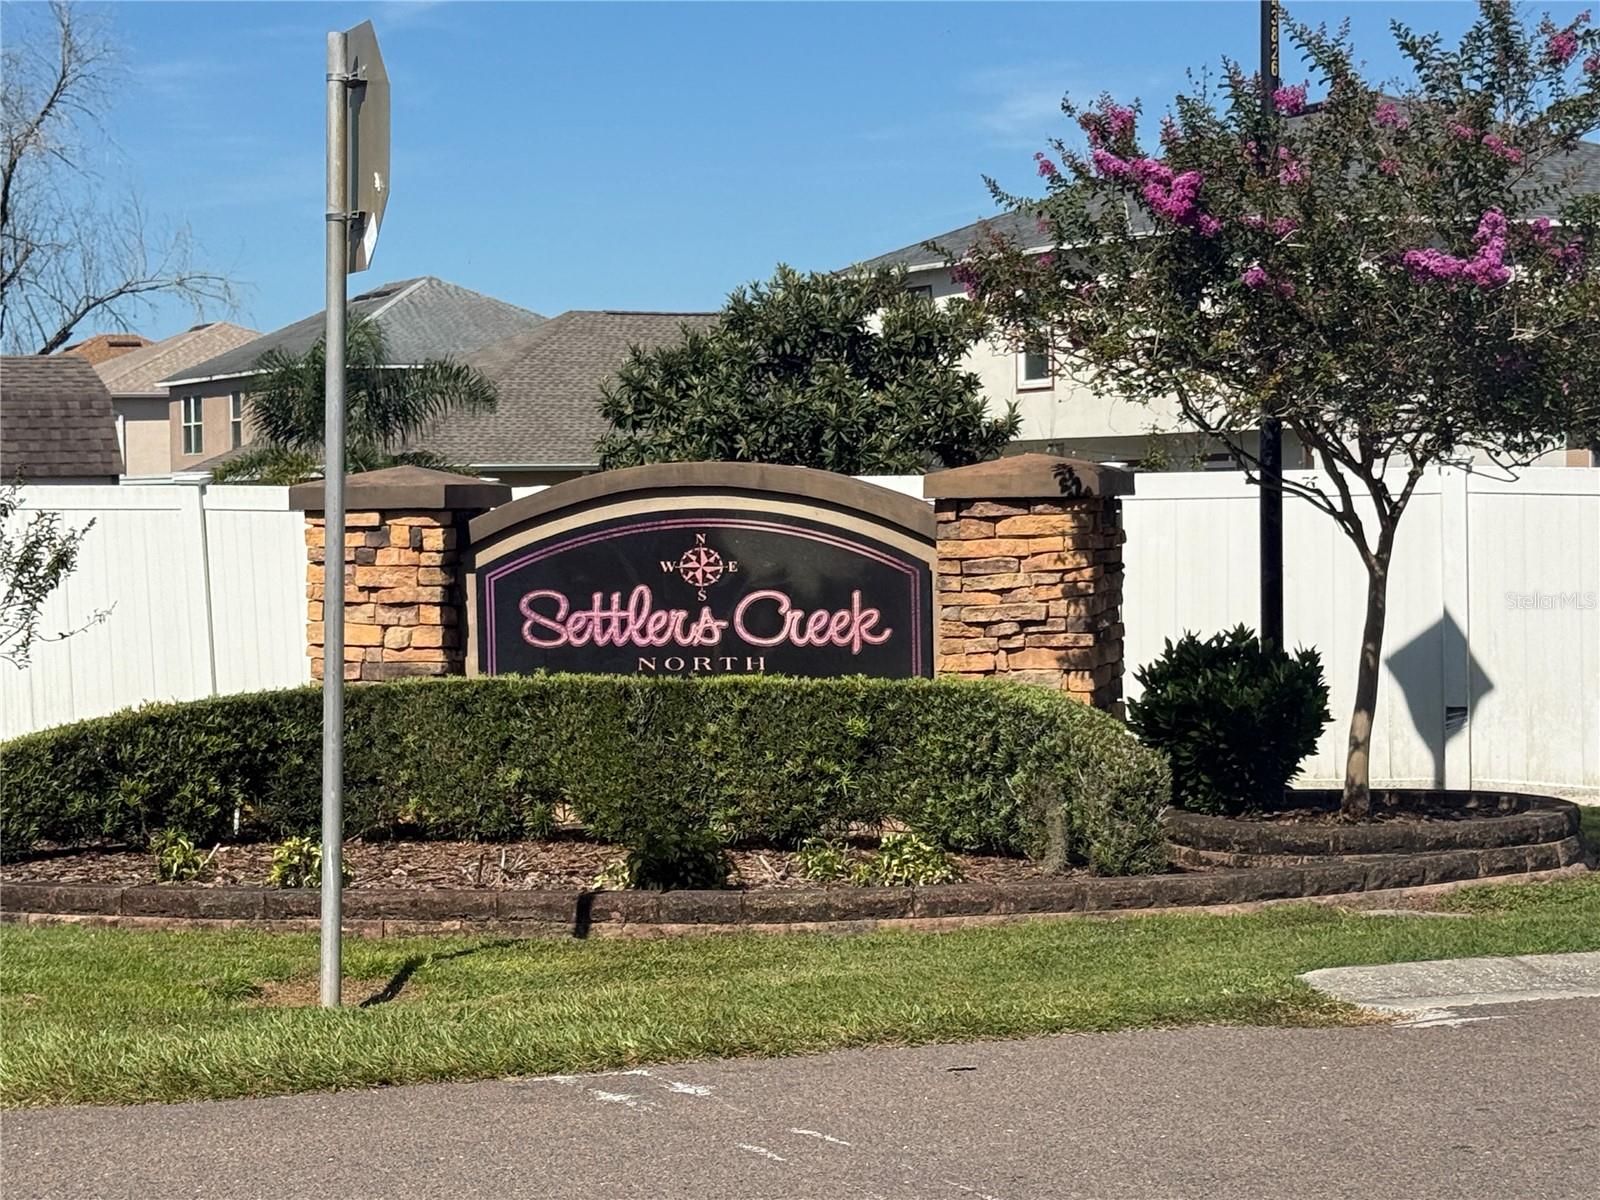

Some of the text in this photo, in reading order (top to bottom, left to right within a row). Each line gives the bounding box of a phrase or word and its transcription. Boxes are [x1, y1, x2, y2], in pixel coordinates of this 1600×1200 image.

[695, 533, 706, 544] N
[660, 561, 676, 573] W
[728, 561, 738, 572] E
[697, 590, 707, 602] S
[519, 584, 893, 655] Settlers Creek
[638, 657, 766, 671] NORTH
